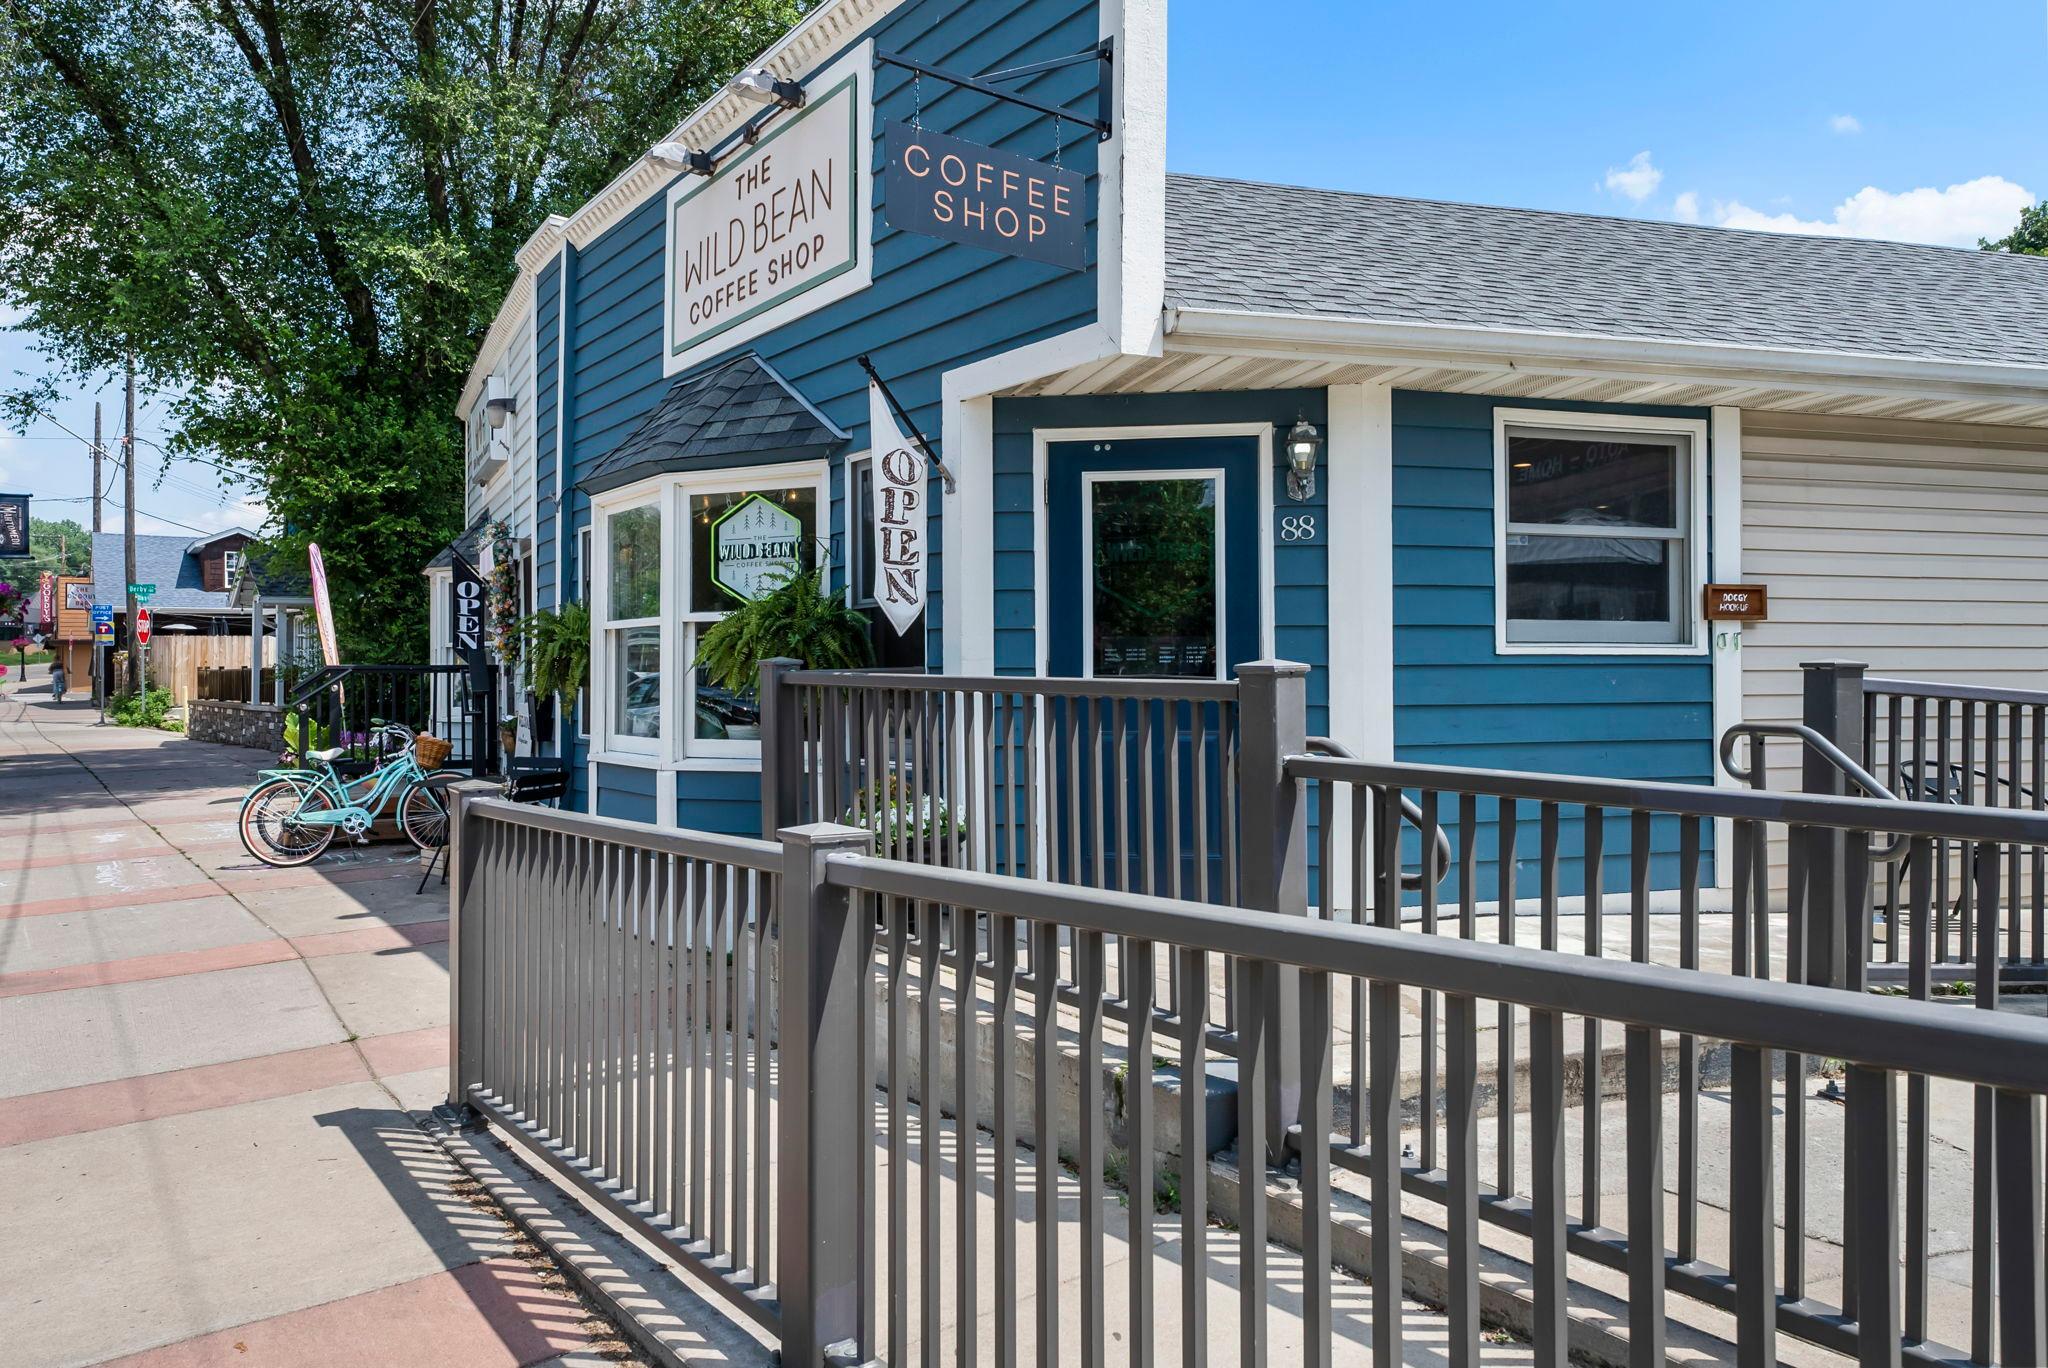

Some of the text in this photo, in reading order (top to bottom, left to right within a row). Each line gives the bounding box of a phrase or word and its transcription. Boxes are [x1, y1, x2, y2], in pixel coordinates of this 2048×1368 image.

[734, 154, 772, 201] THE
[903, 144, 1071, 216] COFFEE
[684, 157, 833, 293] WILD BEAN
[933, 190, 1047, 242] SHOP
[689, 233, 825, 326] COFFEE SHOP
[881, 448, 924, 606] OPEN
[1281, 515, 1315, 541] 88
[130, 585, 147, 593] Derby
[1719, 603, 1749, 612] HOOK-UP
[1723, 593, 1748, 602] DOGGY
[138, 619, 150, 633] STOP
[456, 581, 480, 650] OPEN
